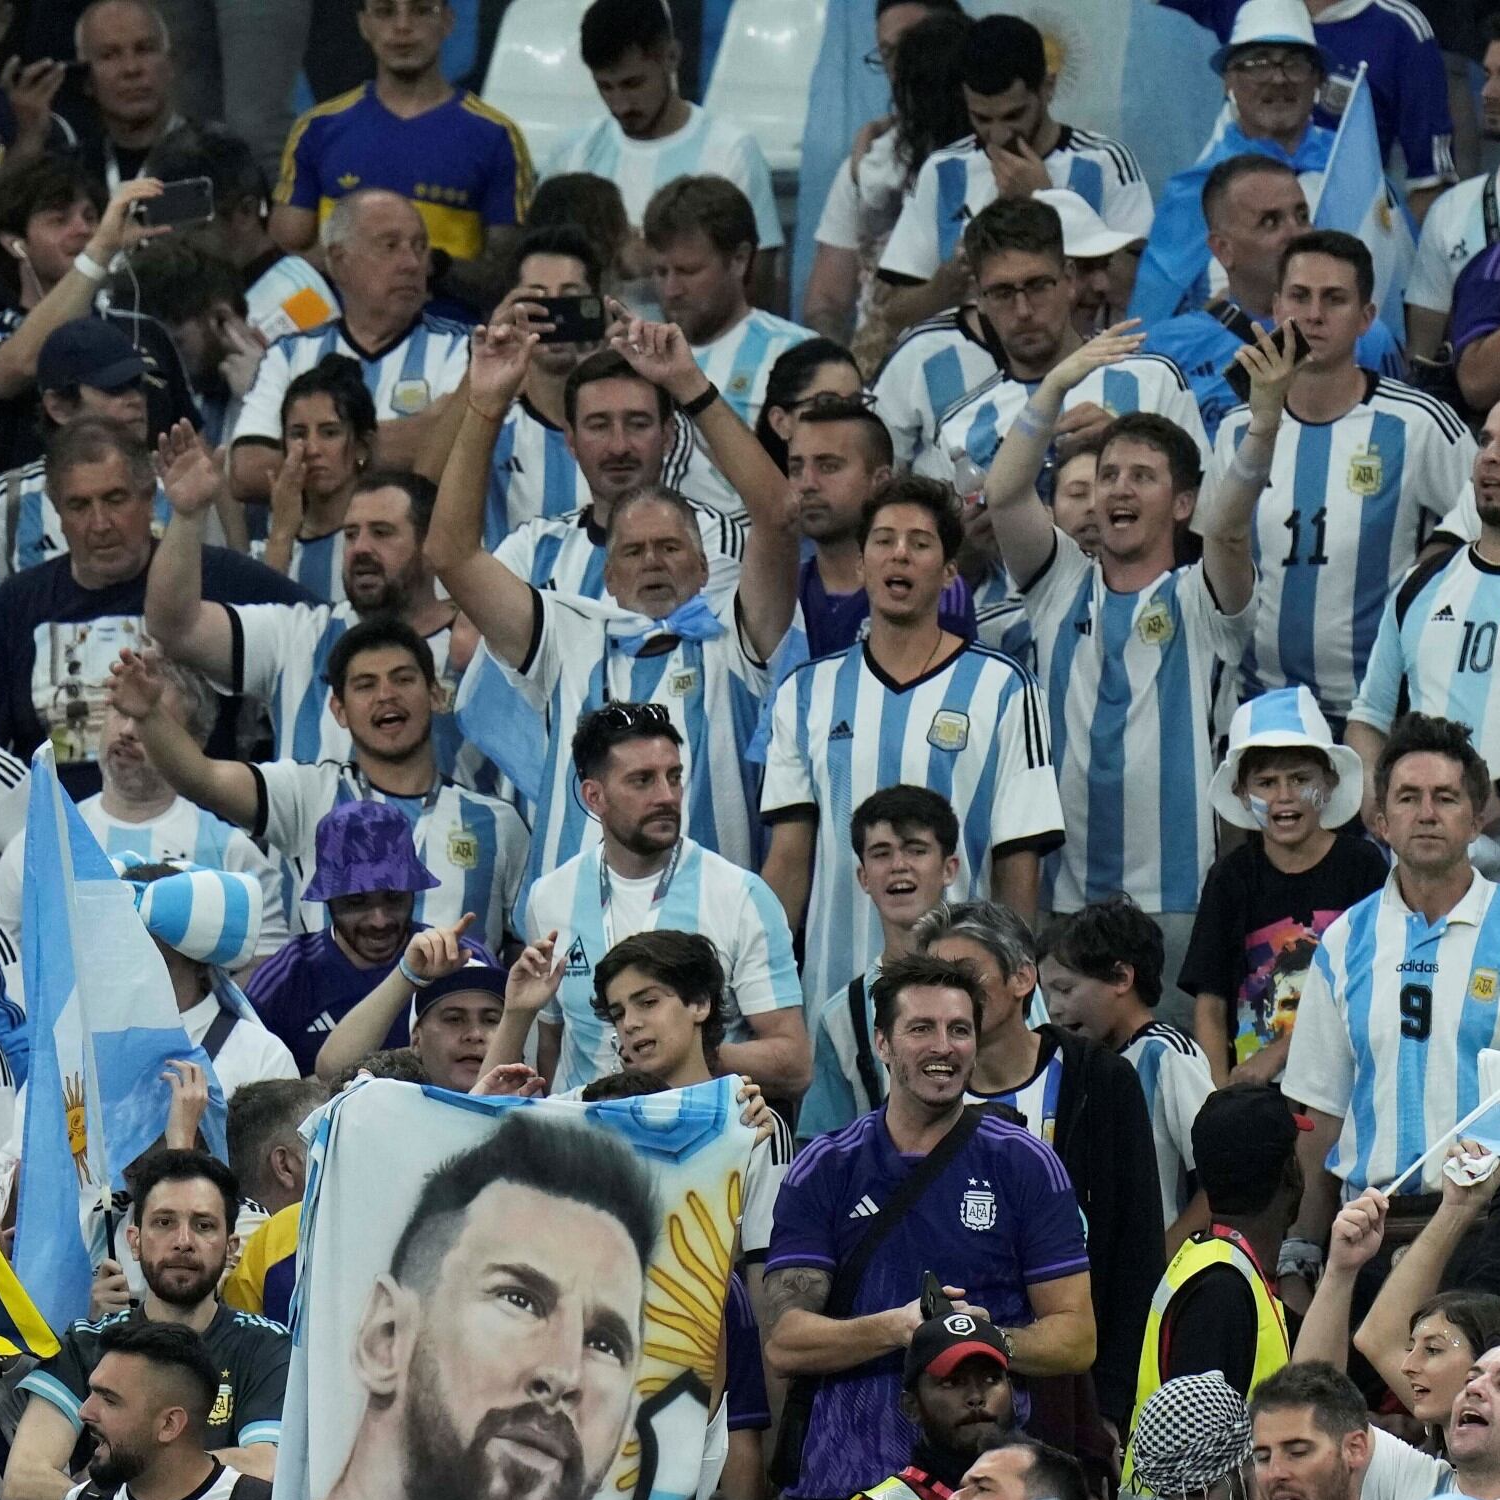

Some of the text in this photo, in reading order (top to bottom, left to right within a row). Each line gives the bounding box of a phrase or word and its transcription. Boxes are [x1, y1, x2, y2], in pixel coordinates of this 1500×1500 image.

[1281, 506, 1330, 569] 11
[1456, 617, 1498, 677] 10
[1395, 960, 1440, 975] adidas
[1399, 983, 1433, 1042] 9
